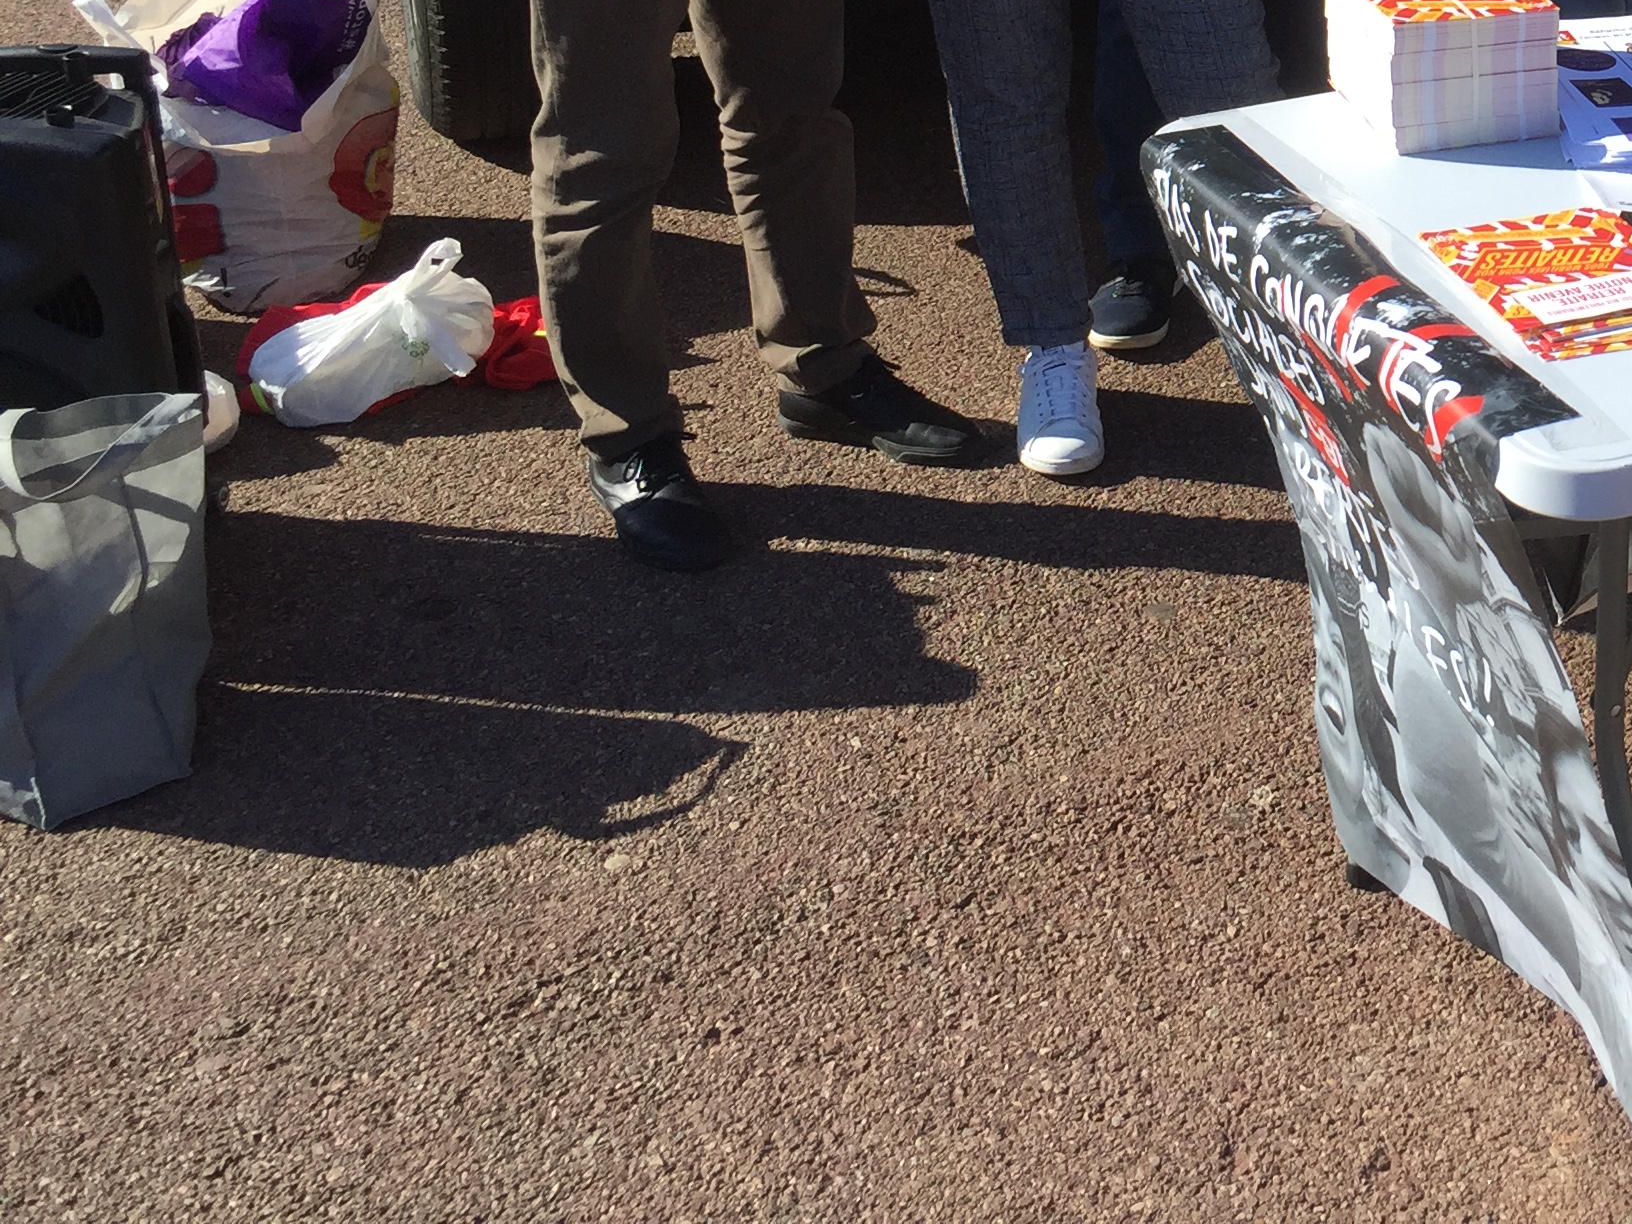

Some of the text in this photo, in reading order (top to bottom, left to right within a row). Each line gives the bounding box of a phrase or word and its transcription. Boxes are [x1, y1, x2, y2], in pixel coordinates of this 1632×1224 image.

[1204, 210, 1241, 283] DE
[1480, 247, 1621, 270] RETRAITES
[1526, 286, 1581, 303] AVENIR
